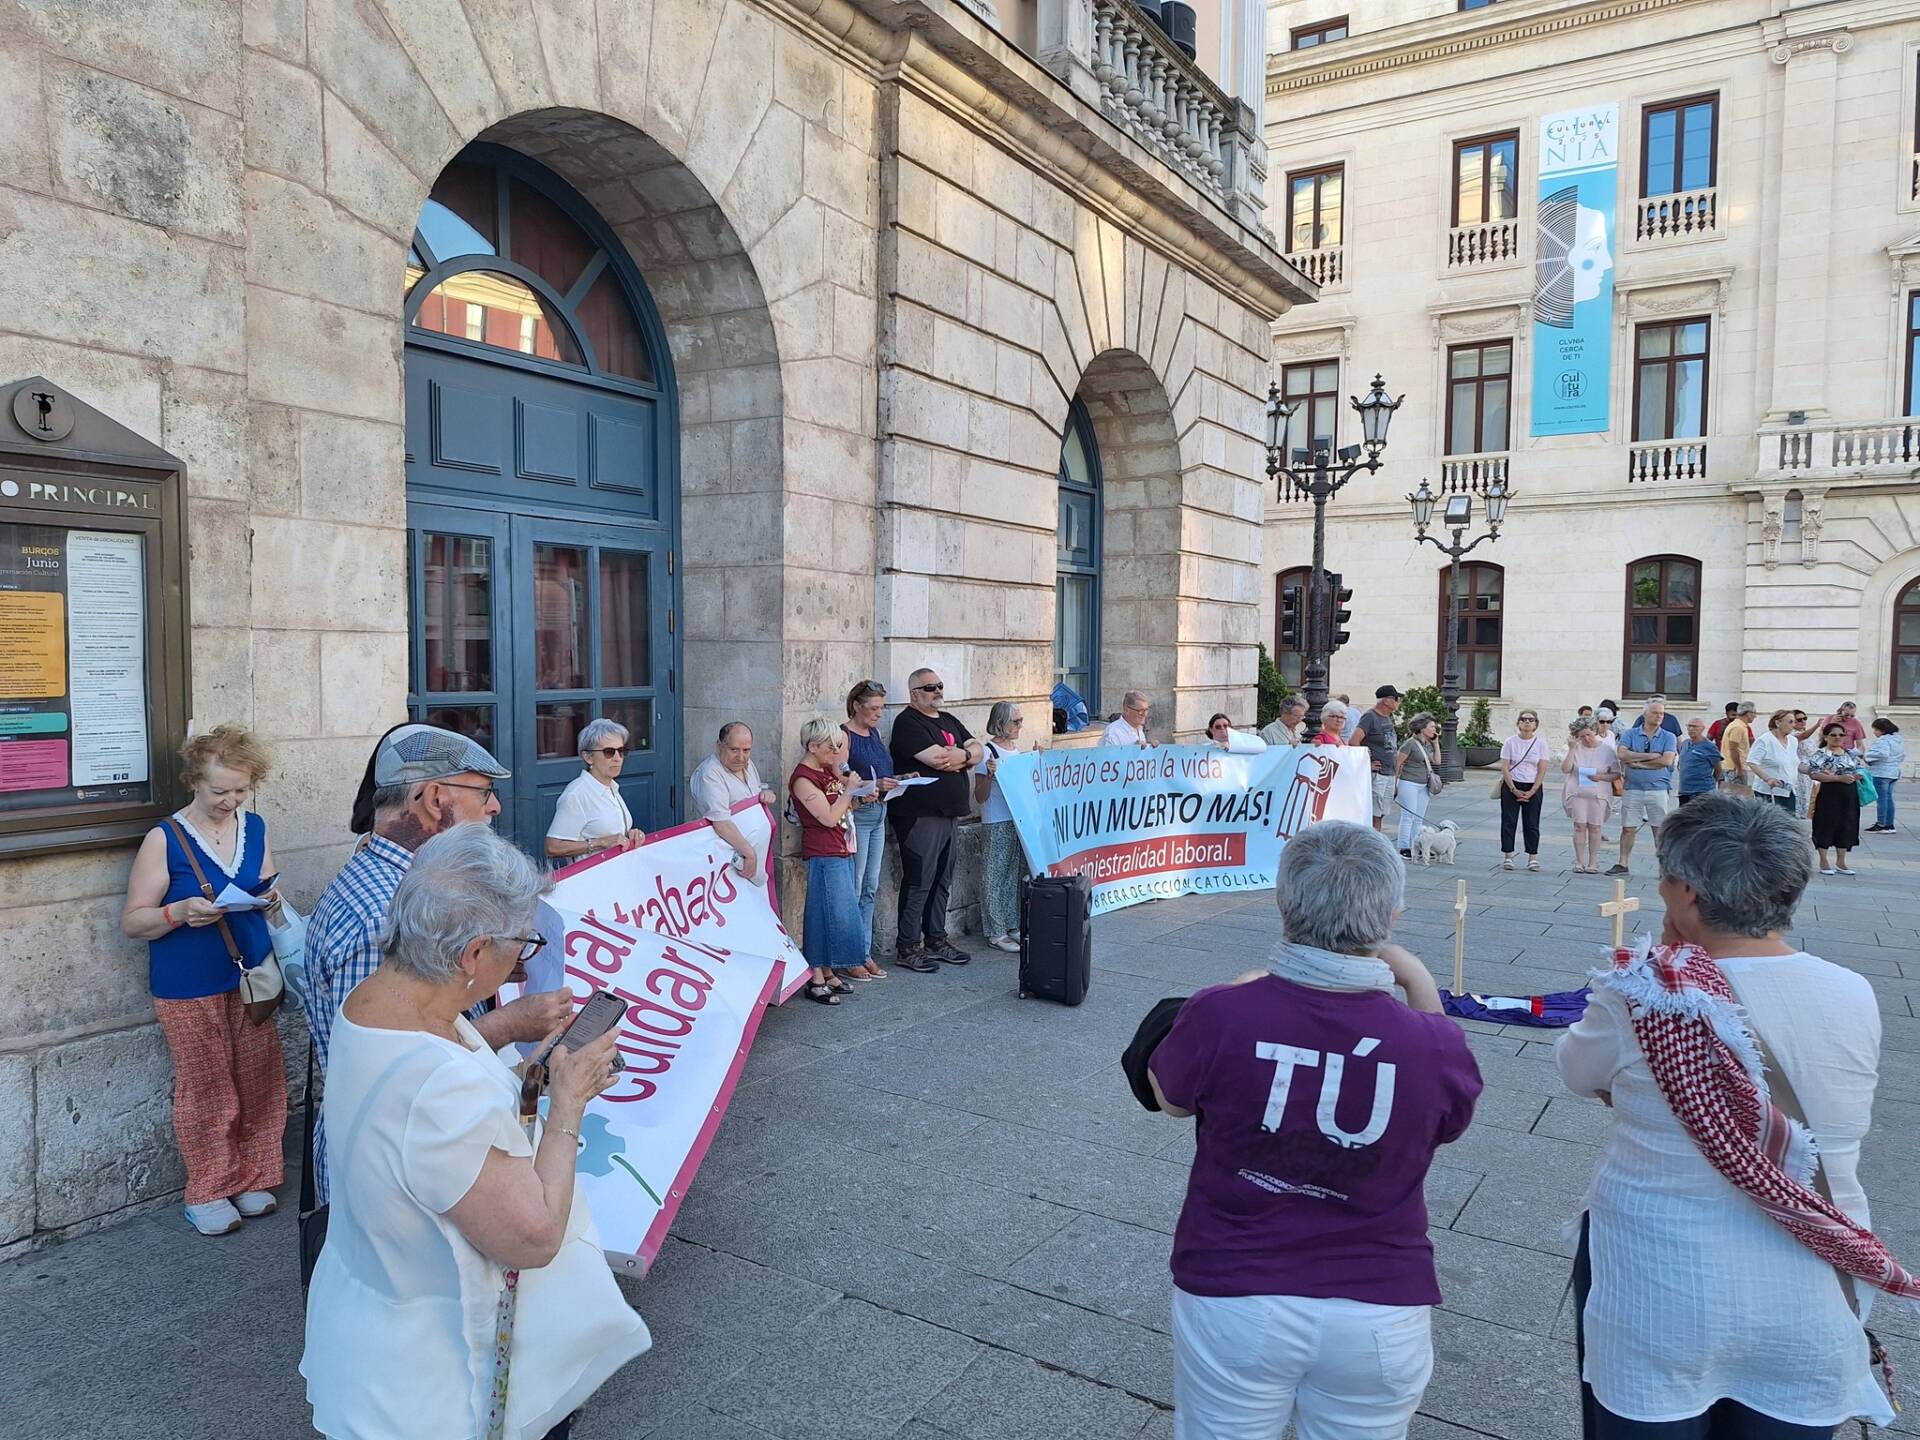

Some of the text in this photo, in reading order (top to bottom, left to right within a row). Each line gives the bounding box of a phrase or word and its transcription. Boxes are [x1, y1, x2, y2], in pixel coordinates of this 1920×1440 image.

[29, 482, 155, 509] PRINCIPAL
[21, 546, 60, 556] BURGOS
[26, 557, 59, 569] Junio
[1032, 750, 1223, 794] el trabajo es para la vida
[1073, 800, 1102, 839] UN
[1106, 792, 1203, 833] MUERTO
[1206, 787, 1273, 827] MÁS!
[1170, 837, 1232, 865] laboral.
[1093, 887, 1129, 908] BRERA
[1130, 884, 1146, 898] DE
[1195, 872, 1270, 890] CATÓLICA
[1255, 1037, 1397, 1149] TÚ
